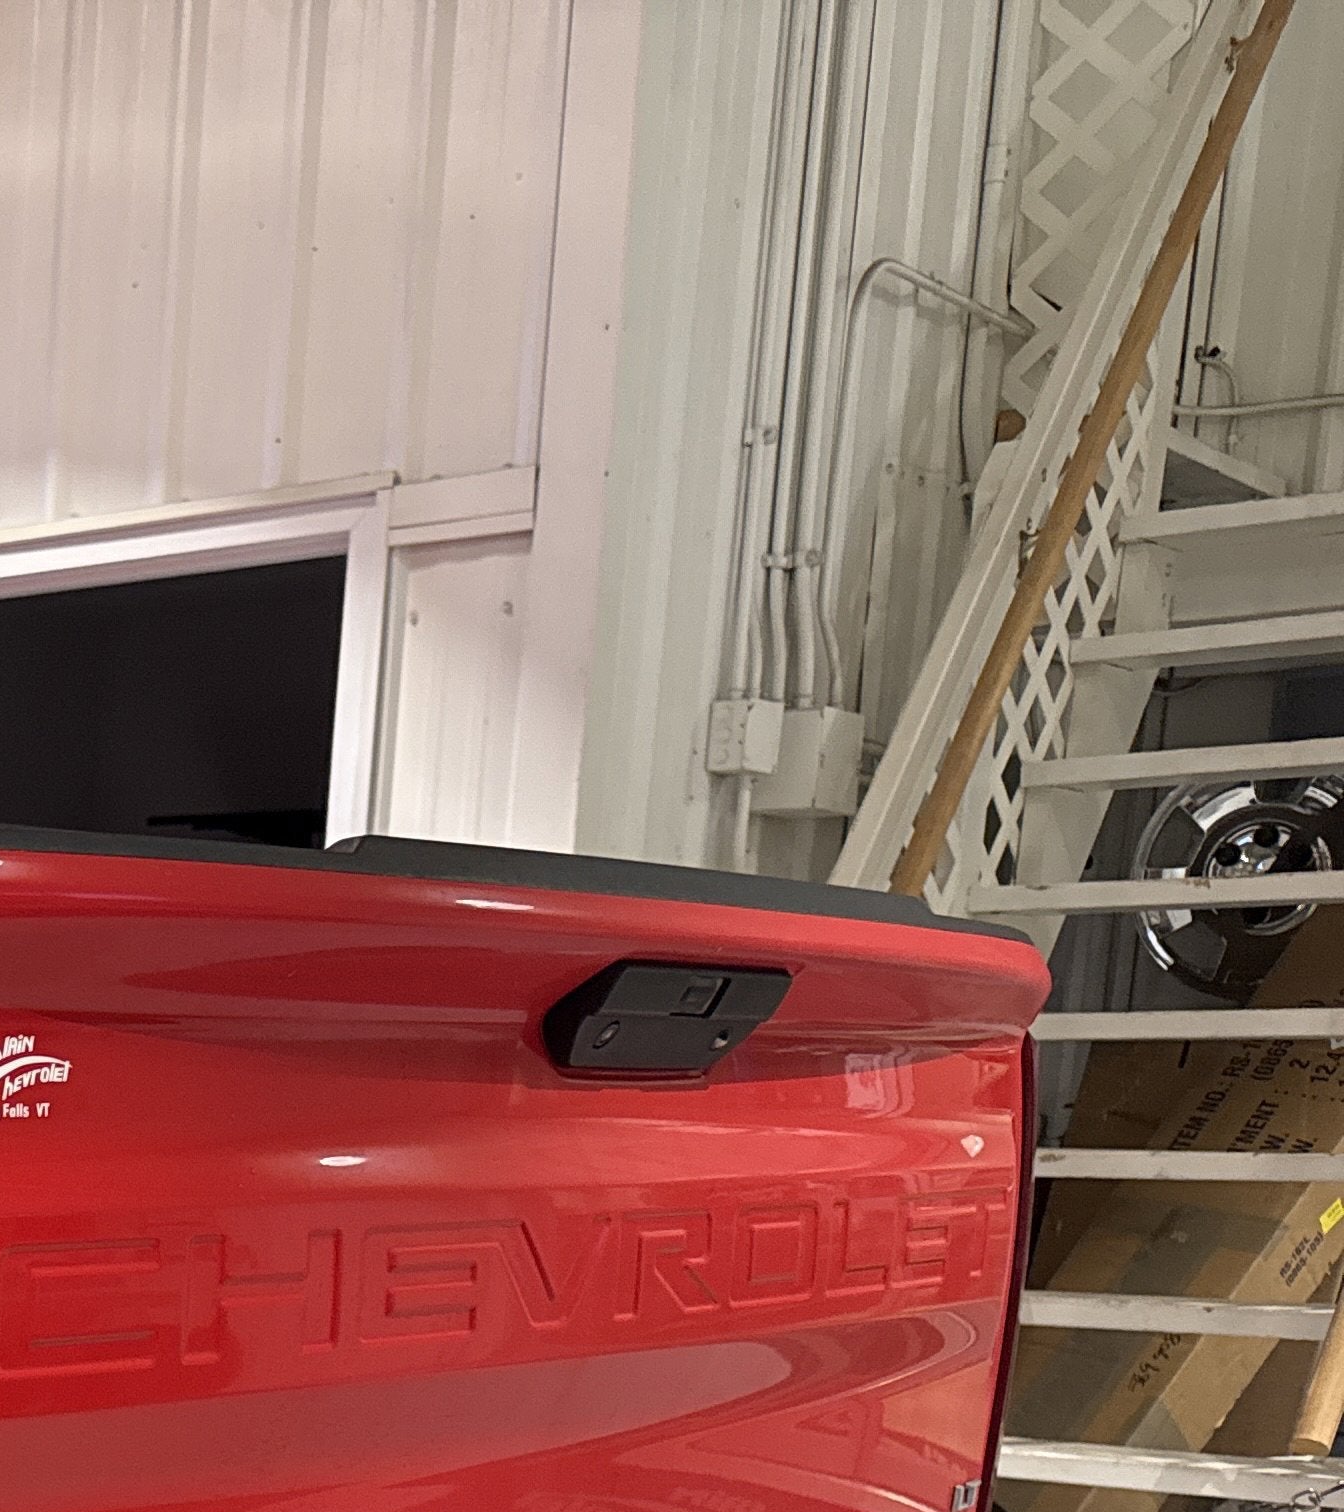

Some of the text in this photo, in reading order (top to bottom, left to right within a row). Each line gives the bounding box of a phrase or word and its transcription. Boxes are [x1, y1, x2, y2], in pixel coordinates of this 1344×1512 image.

[1289, 1058, 1310, 1069] 2
[2, 1102, 30, 1118] Falls
[36, 1102, 50, 1118] VT
